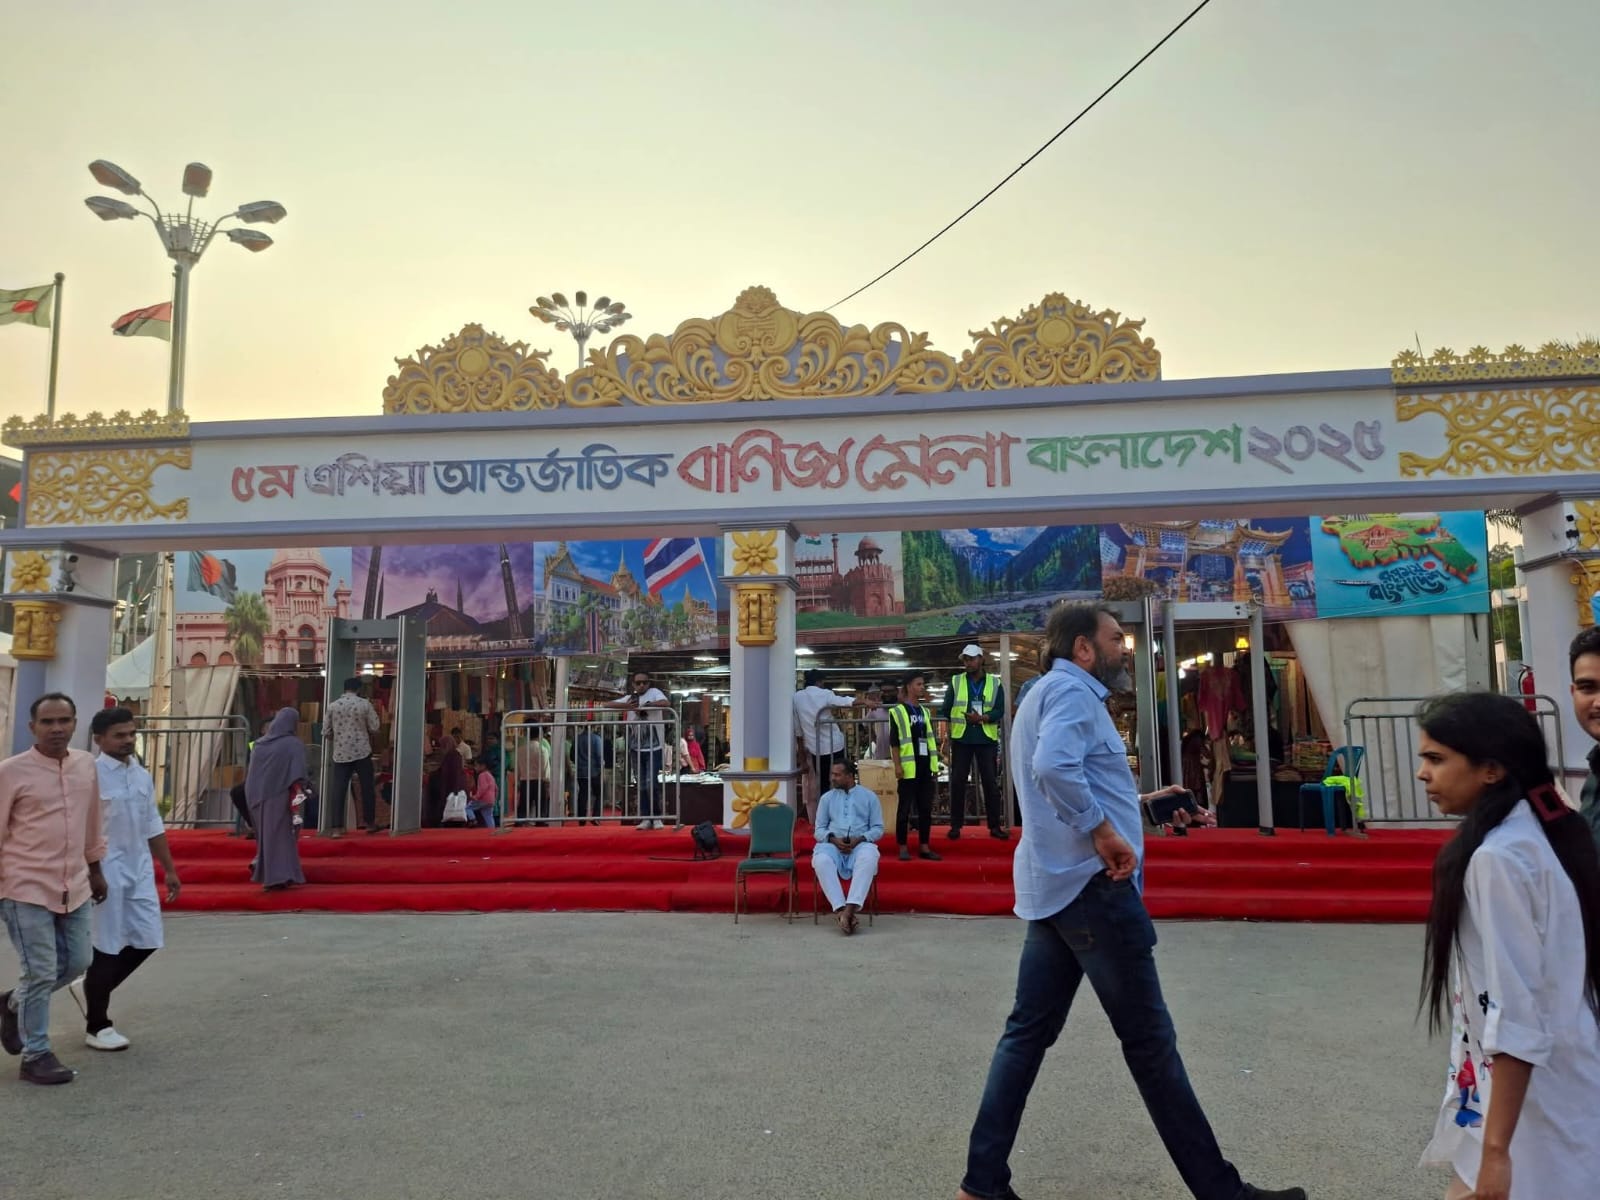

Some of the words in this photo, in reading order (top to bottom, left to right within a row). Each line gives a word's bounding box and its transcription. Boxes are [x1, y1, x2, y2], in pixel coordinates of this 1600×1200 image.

[231, 464, 298, 502] ৫ম
[304, 452, 430, 496] এশিয়া
[433, 443, 674, 495] আন্তর্জাতিক
[1026, 422, 1242, 473] বাংলাদেশ
[1248, 419, 1385, 475] ২০২৫
